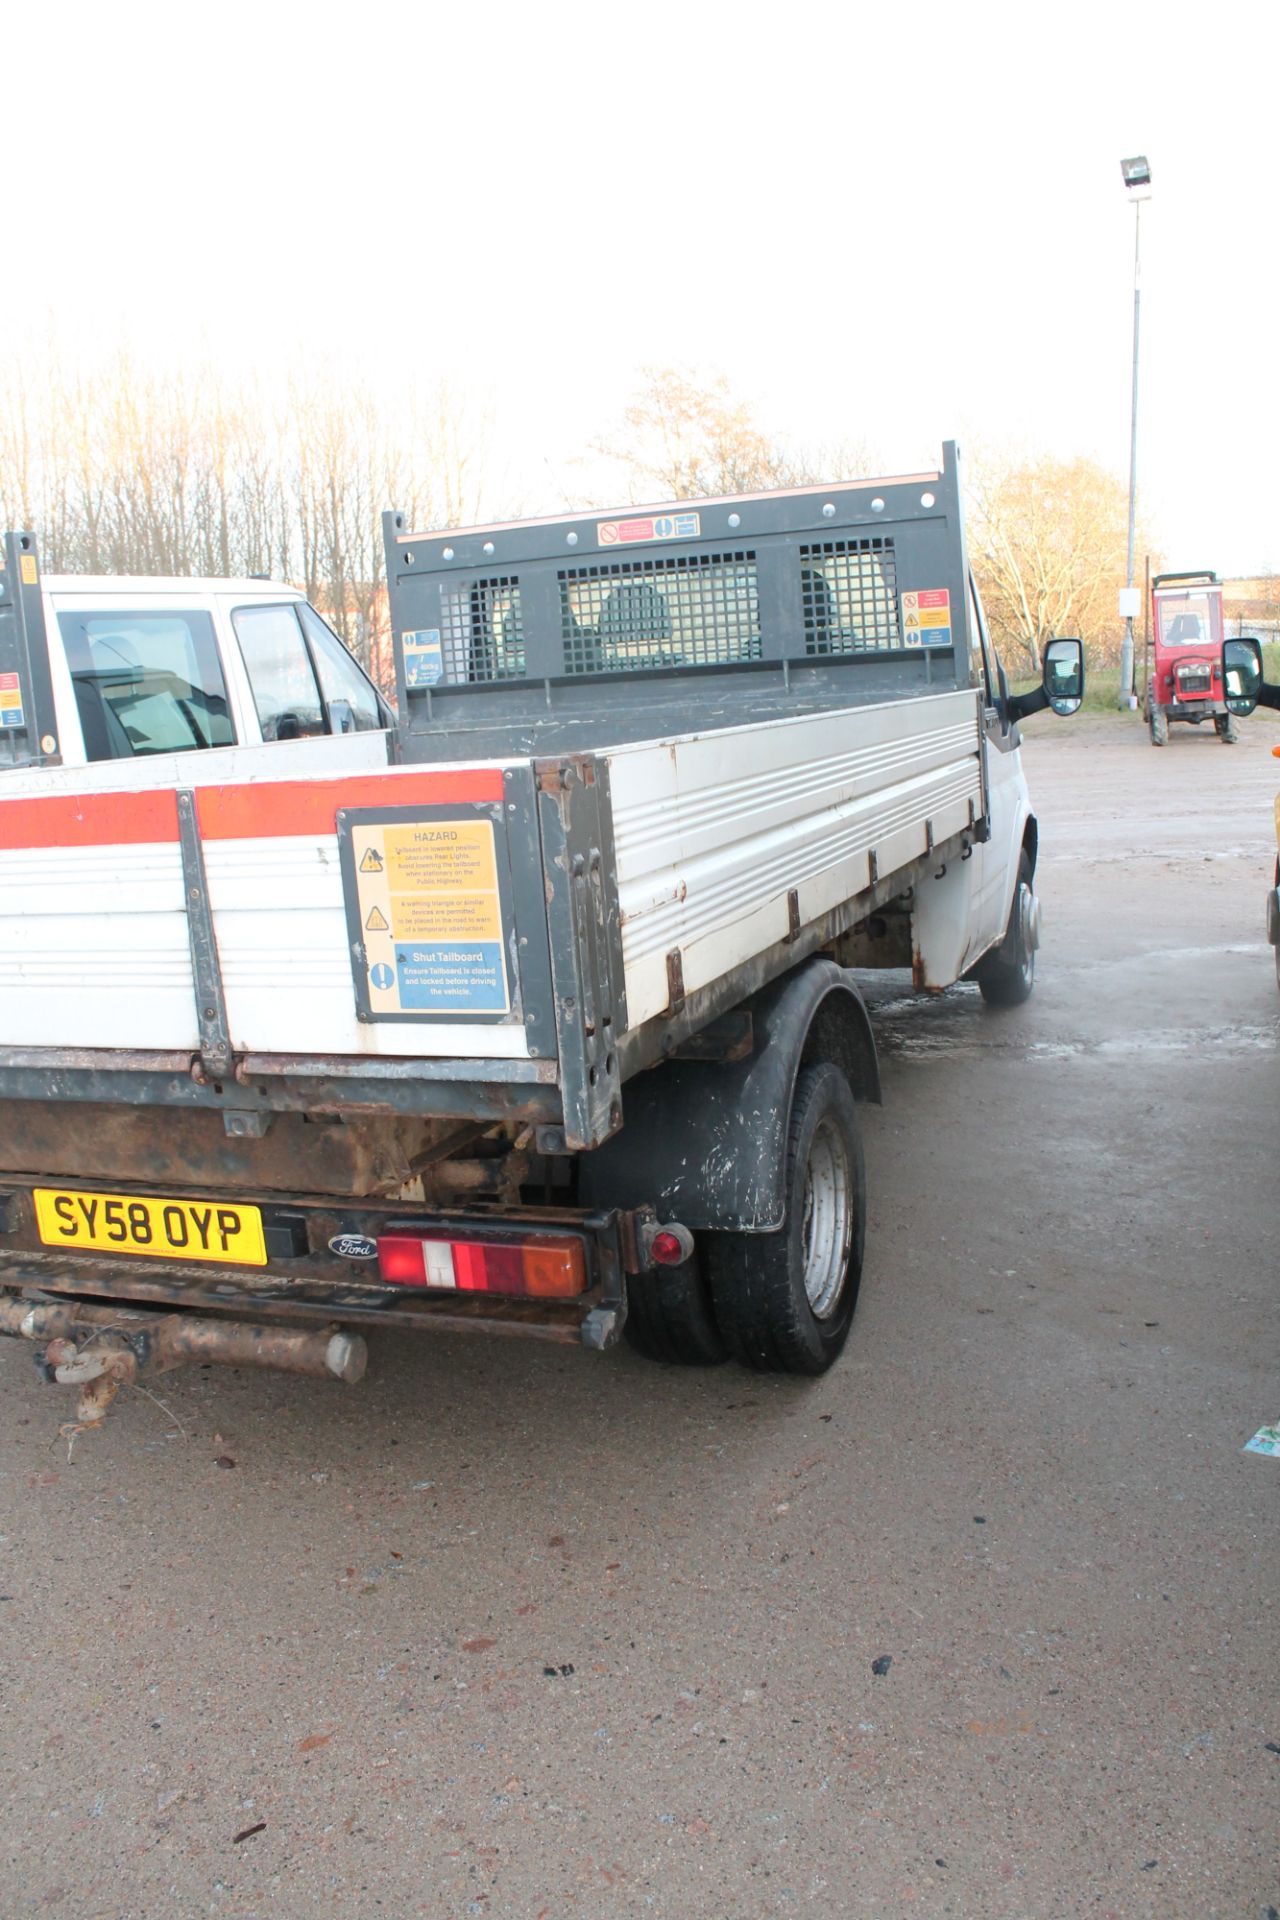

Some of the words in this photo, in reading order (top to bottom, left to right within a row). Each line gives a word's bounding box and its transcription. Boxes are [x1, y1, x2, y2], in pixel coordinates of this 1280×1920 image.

[414, 831, 458, 842] HAZARD
[413, 952, 436, 962] Shut
[437, 951, 483, 962] Tailboard
[404, 967, 430, 975] Ensure
[420, 977, 444, 985] locked
[471, 977, 496, 986] driving
[54, 1196, 153, 1245] SY58
[163, 1206, 241, 1252] OYP
[339, 1239, 370, 1255] Ford
